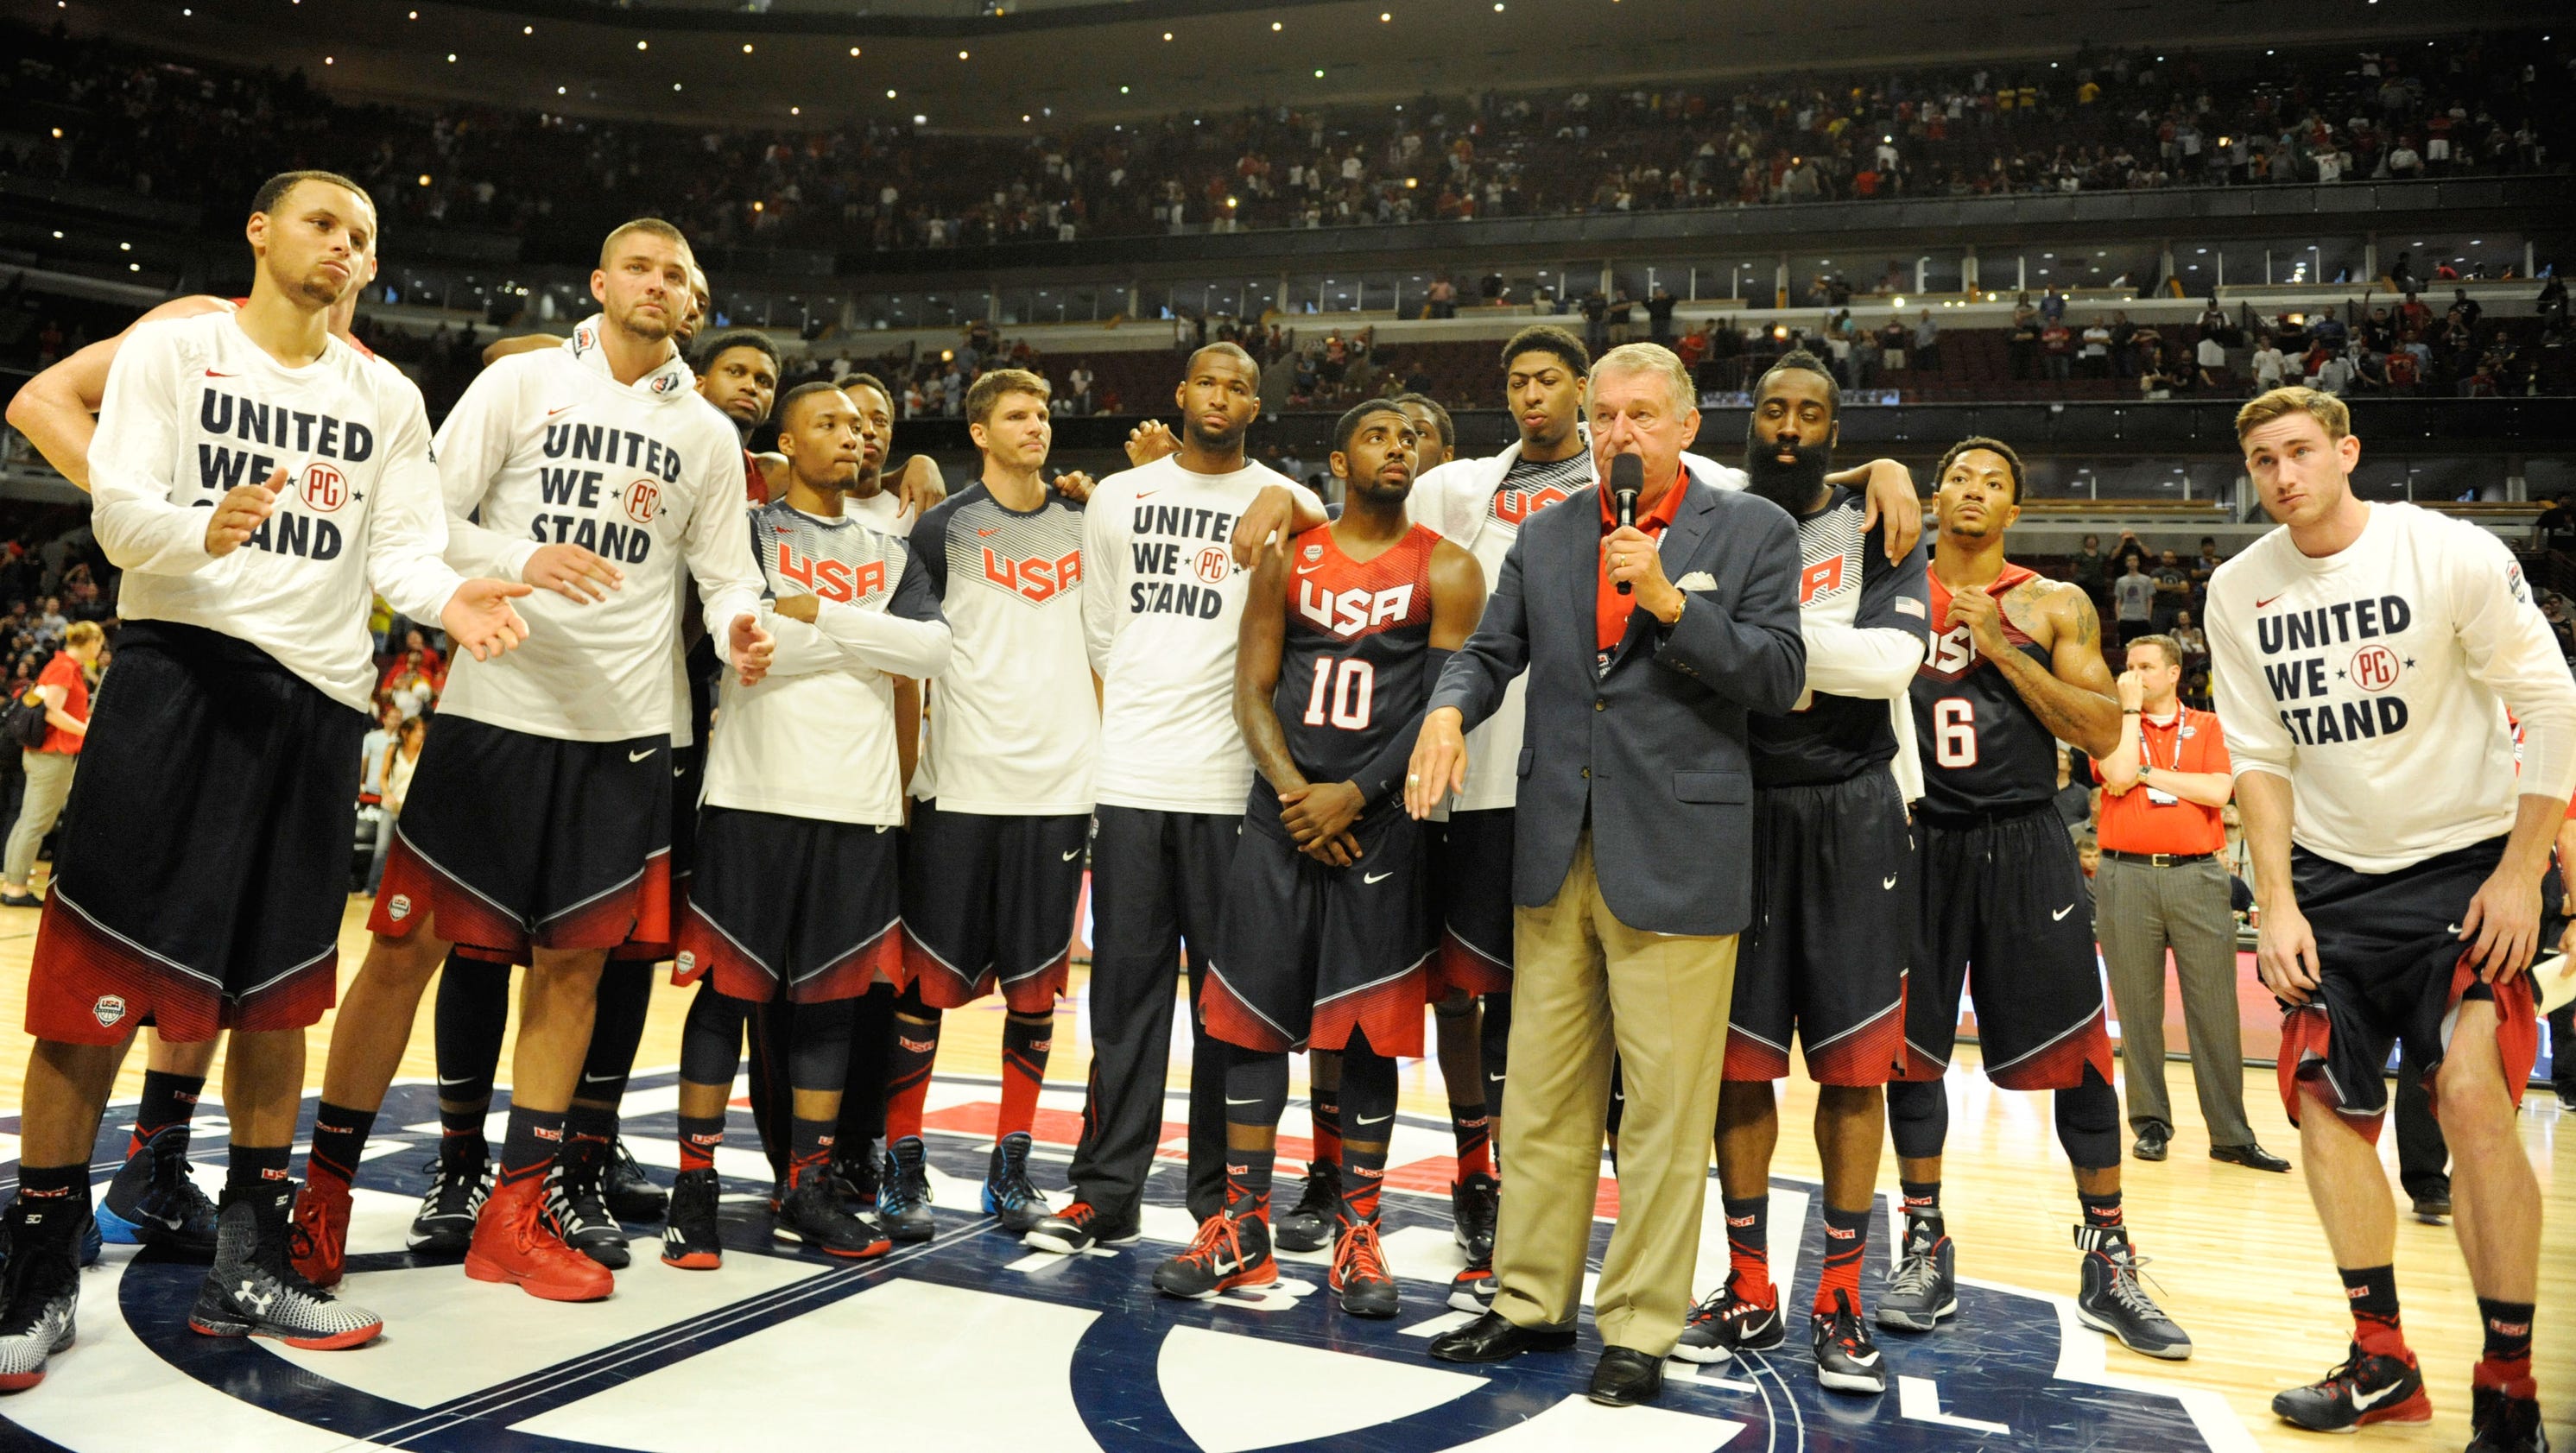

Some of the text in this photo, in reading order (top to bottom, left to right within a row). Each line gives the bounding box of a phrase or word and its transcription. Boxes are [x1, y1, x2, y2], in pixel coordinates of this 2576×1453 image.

[200, 388, 373, 462] UNITED
[199, 444, 339, 507] WE PG
[543, 424, 681, 483] UNITED
[541, 467, 657, 518] WE PG
[192, 499, 342, 560] AND
[1133, 505, 1241, 544] UNITE
[779, 542, 886, 603] USA
[982, 546, 1082, 603] USA
[1132, 542, 1224, 578] WE PG
[1130, 582, 1222, 620] STAND
[1300, 578, 1415, 637] USA
[2257, 595, 2410, 654] UNITED
[1304, 656, 1375, 731] 10
[2264, 651, 2389, 701] WE PG
[1934, 697, 1978, 768] 6
[2280, 696, 2408, 745] STAND
[900, 1036, 934, 1052] USA
[1029, 1038, 1051, 1052] US
[534, 1127, 563, 1141] US
[261, 1168, 289, 1180] US
[1227, 1163, 1248, 1175] SA
